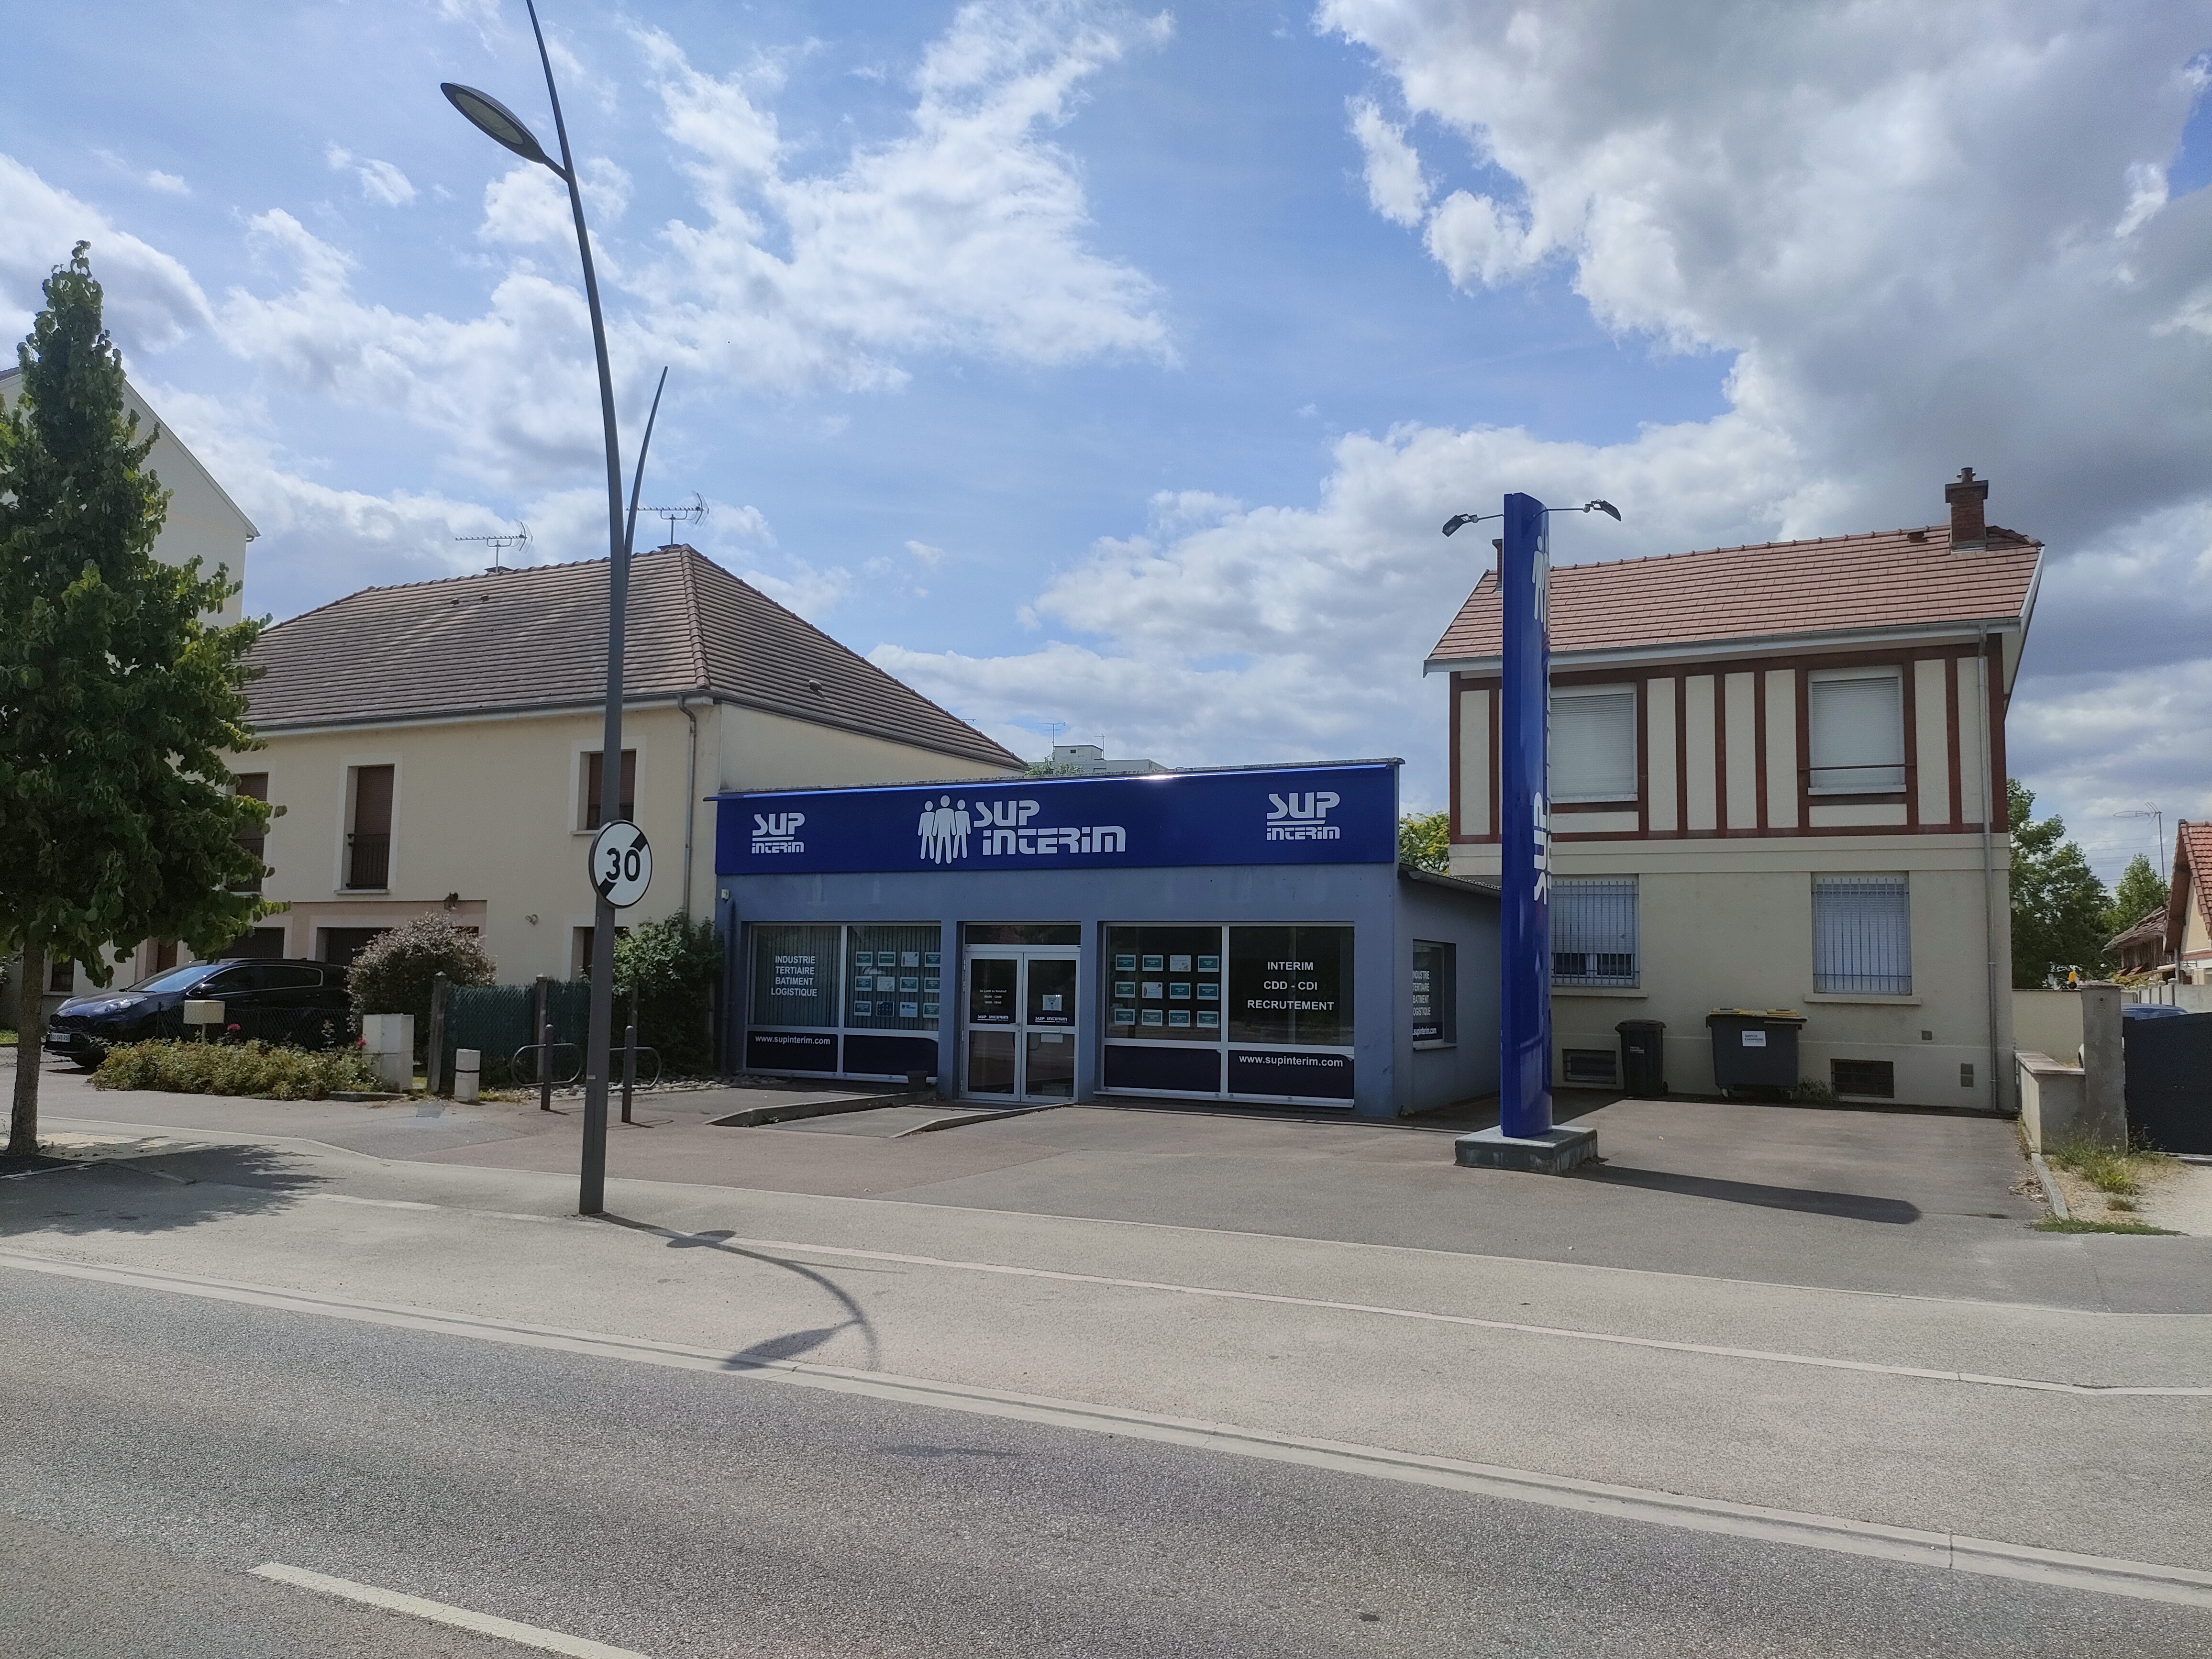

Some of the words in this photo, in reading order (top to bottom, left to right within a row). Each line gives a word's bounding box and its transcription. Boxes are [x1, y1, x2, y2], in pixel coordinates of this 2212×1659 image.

[1267, 792, 1340, 819] SUP
[973, 800, 1040, 827] SUP
[752, 813, 805, 836] SUP
[1534, 792, 1547, 905] SUP
[606, 848, 641, 882] 30
[775, 956, 816, 964] INDUSTRIE
[775, 966, 815, 974] TERTIAIRE
[1267, 962, 1314, 971] INTERIM
[1413, 971, 1430, 979] NDUSTRIE
[775, 977, 814, 985] BATIMENT
[1263, 981, 1287, 990] CDD
[1298, 982, 1317, 990] CDI
[771, 987, 817, 996] LOGISTIQUE
[1413, 983, 1429, 992] TERTIAIRE
[1413, 995, 1429, 1004] BATIMENT
[1248, 1000, 1335, 1010] RECRUTEMENT
[1413, 1007, 1431, 1016] OGISTIQUE
[1413, 1027, 1437, 1037] .supinterim.com
[755, 1035, 830, 1045] www.supinterim.com
[1239, 1056, 1343, 1067] www.supinterim.com
